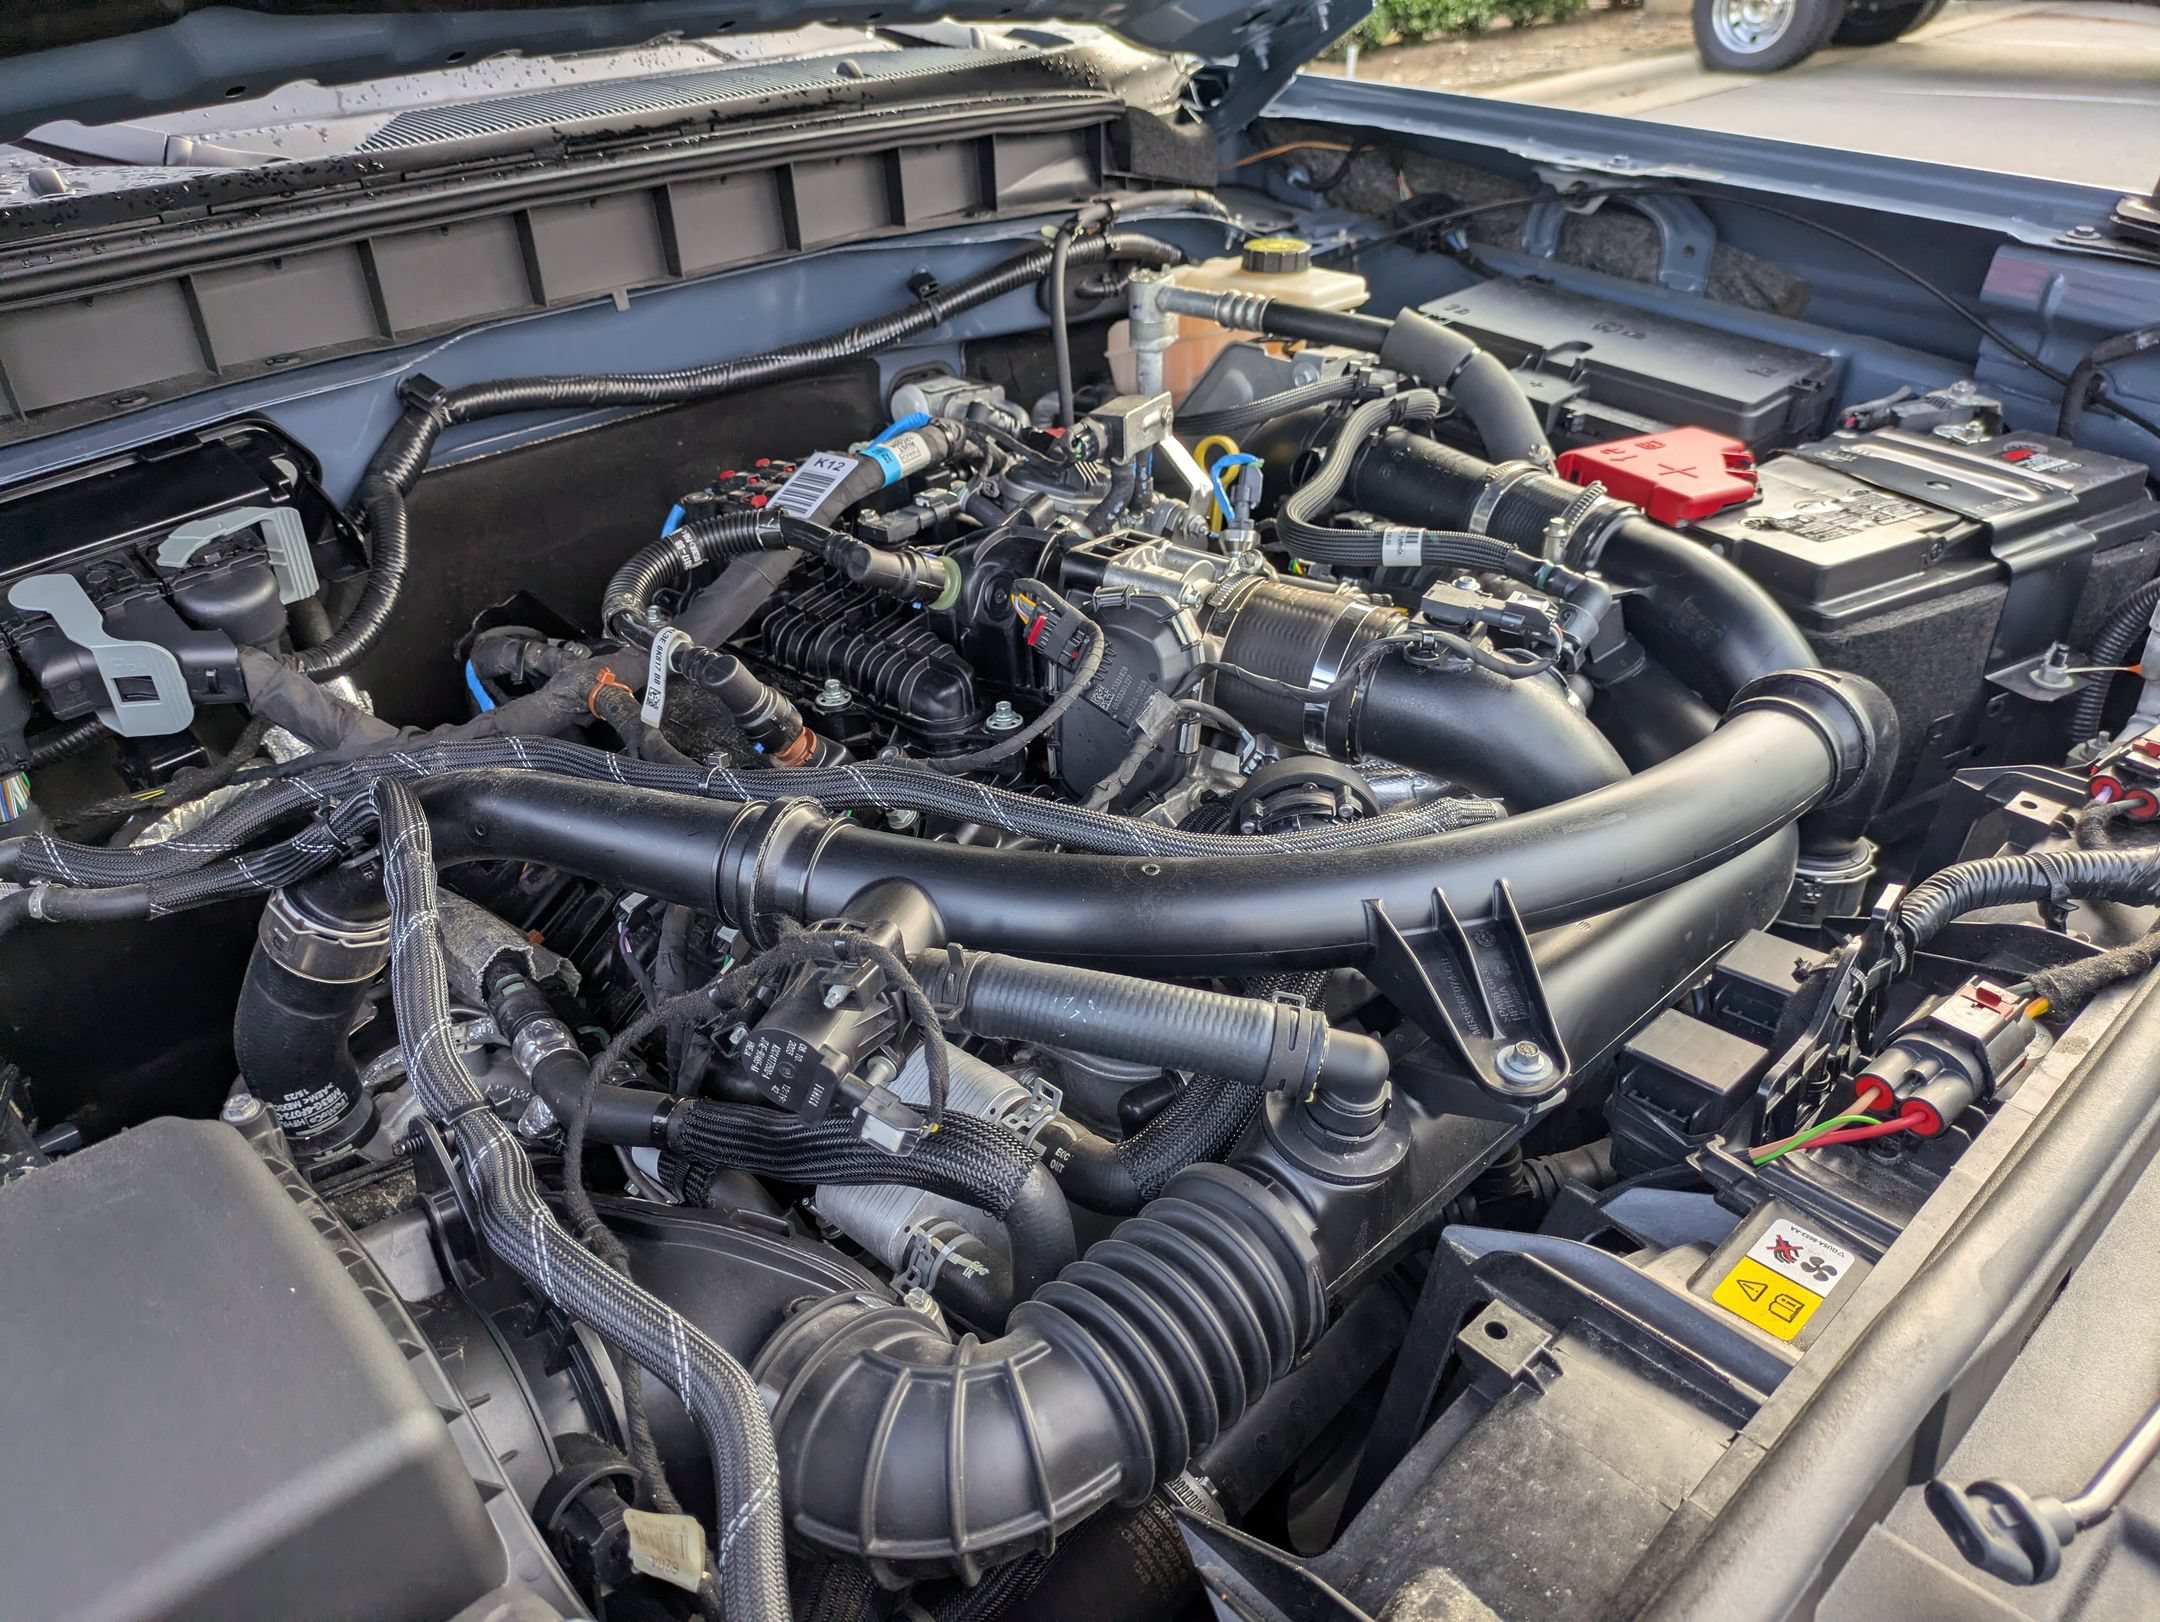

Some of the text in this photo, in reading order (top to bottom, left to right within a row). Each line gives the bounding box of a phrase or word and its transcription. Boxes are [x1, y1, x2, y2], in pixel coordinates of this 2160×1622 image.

[814, 457, 846, 472] K12
[283, 1088, 310, 1101] 15/23
[309, 1098, 346, 1124] FoMoCo
[1050, 1158, 1065, 1173] OUT
[962, 1266, 975, 1279] IN
[1149, 1499, 1180, 1538] FoMoCo
